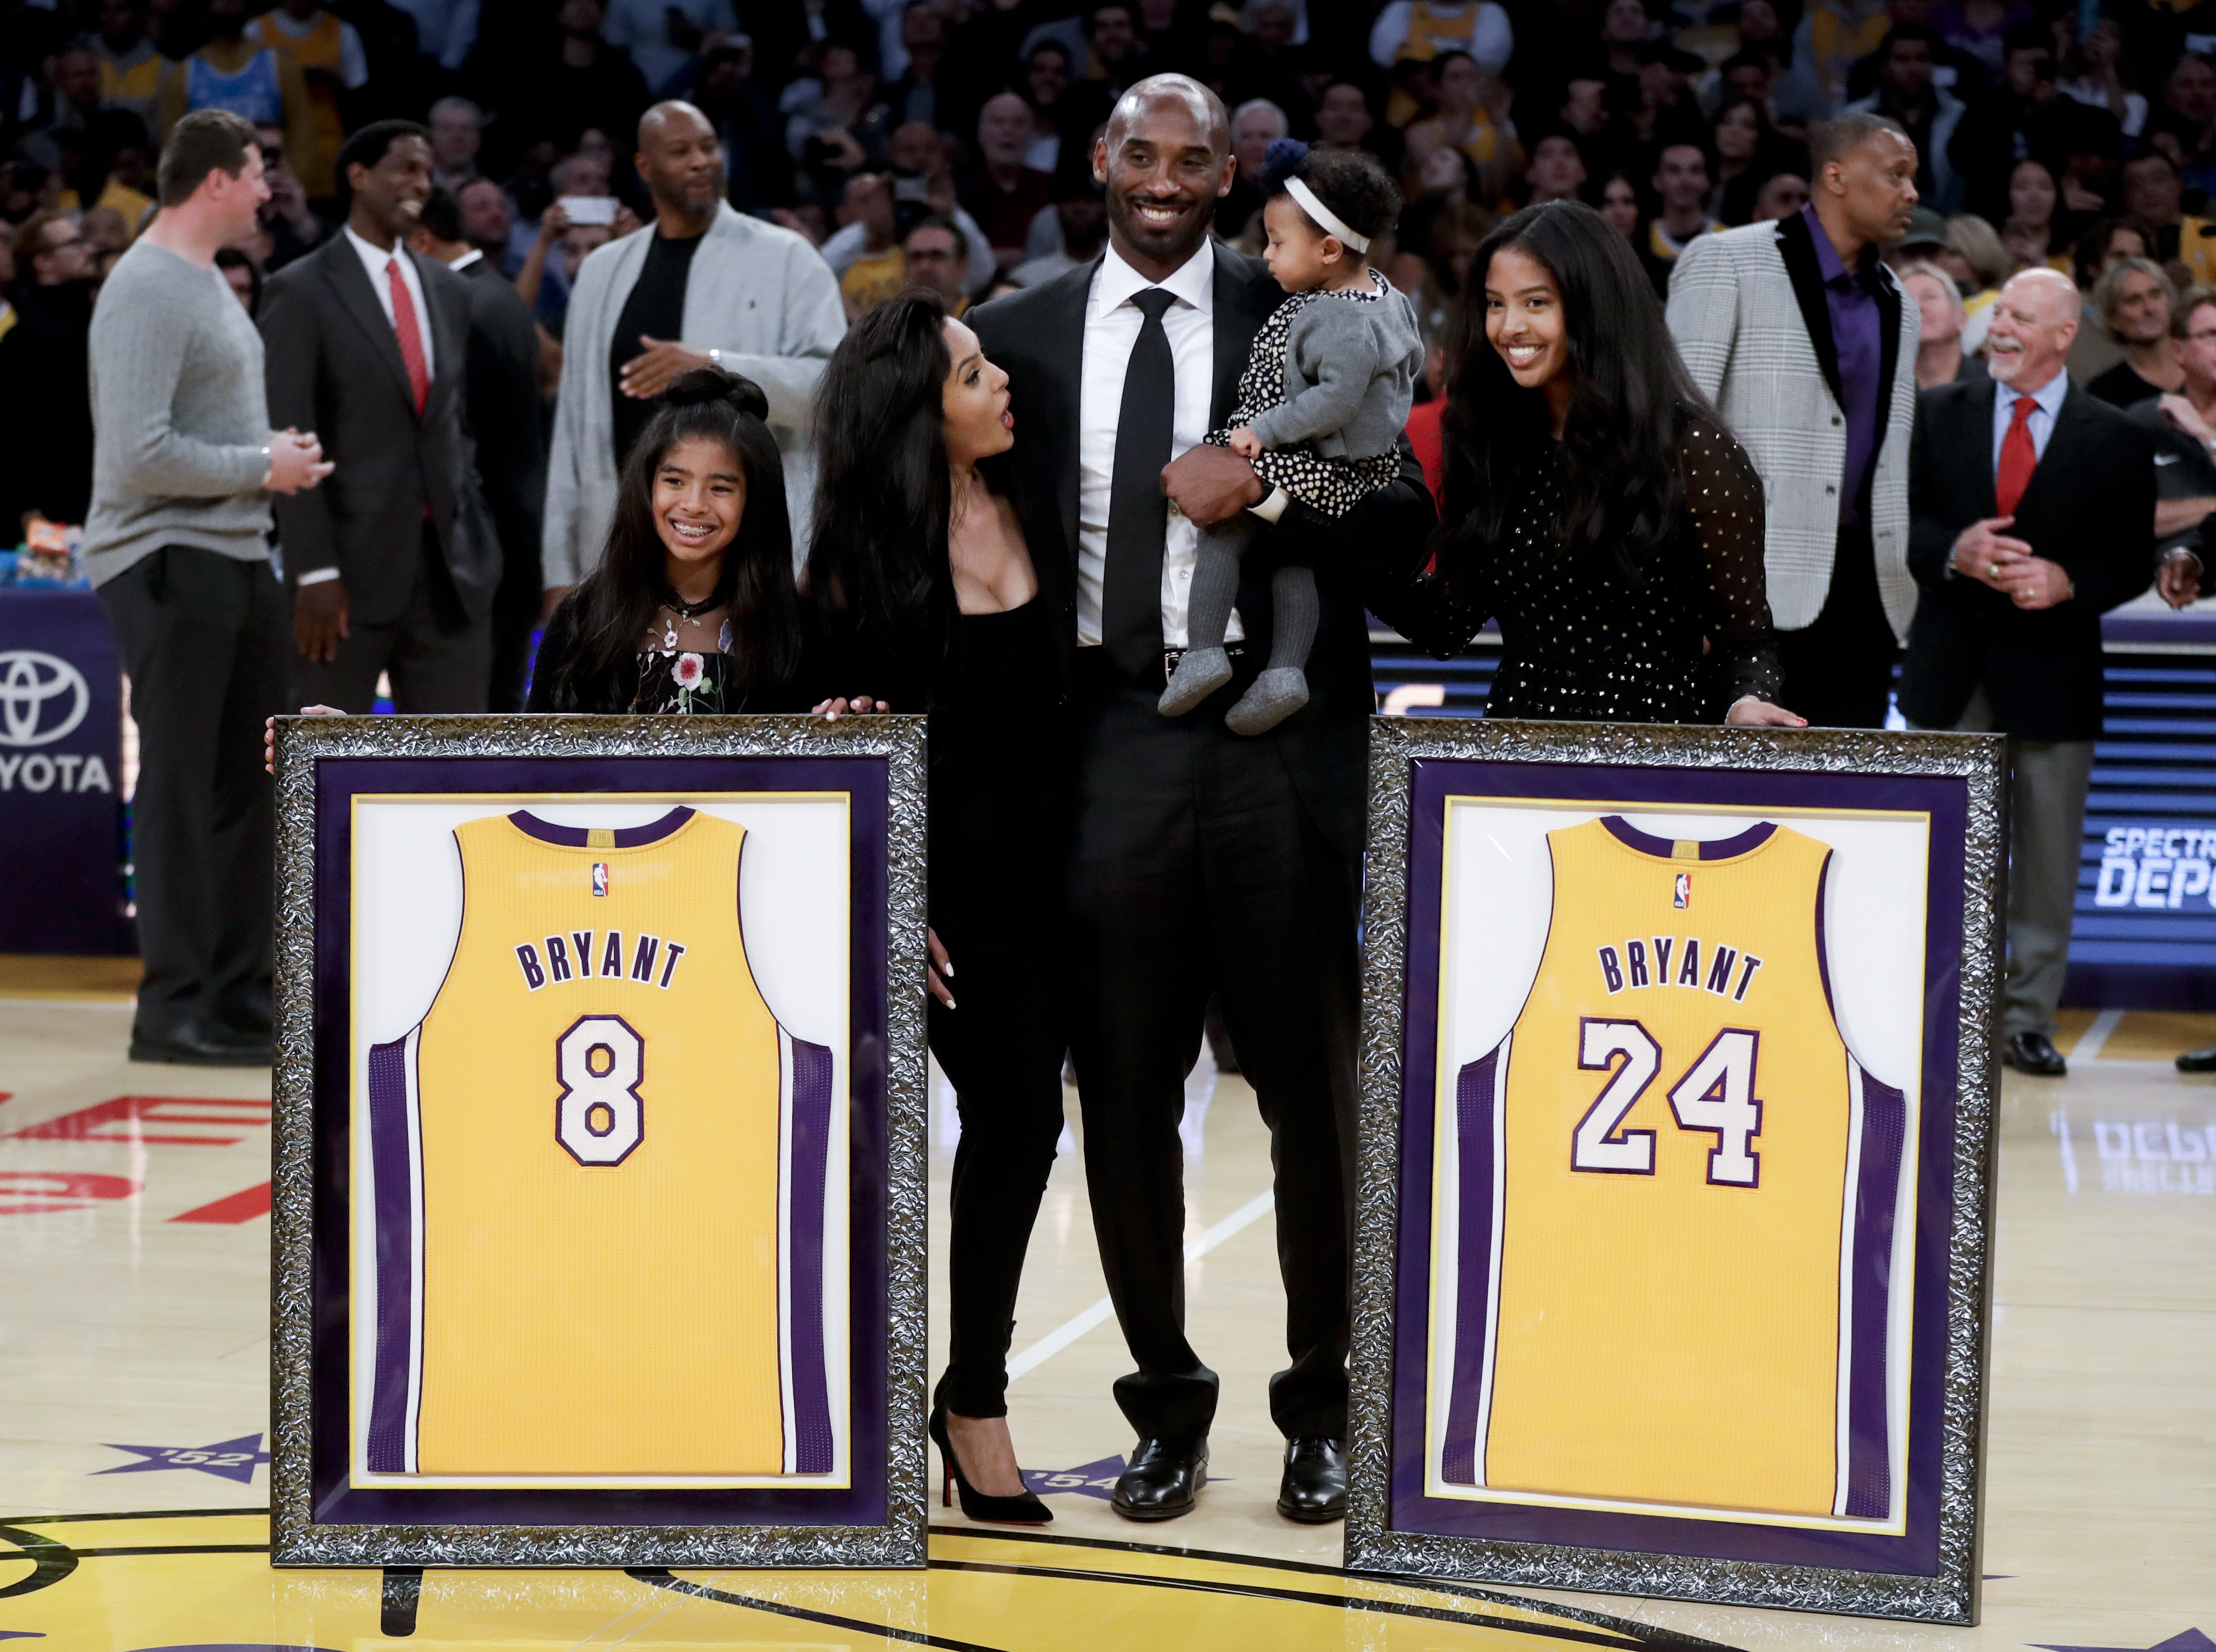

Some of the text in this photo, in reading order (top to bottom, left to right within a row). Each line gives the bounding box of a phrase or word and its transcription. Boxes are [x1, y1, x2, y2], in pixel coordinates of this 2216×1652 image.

[2095, 857, 2216, 909] DEP
[514, 928, 688, 992] BRYANT
[1596, 935, 1764, 1004] BRYANT
[554, 1014, 645, 1167] 8
[1570, 1016, 1763, 1189] 24
[160, 1449, 254, 1467] '52
[1031, 1472, 1120, 1490] '54
